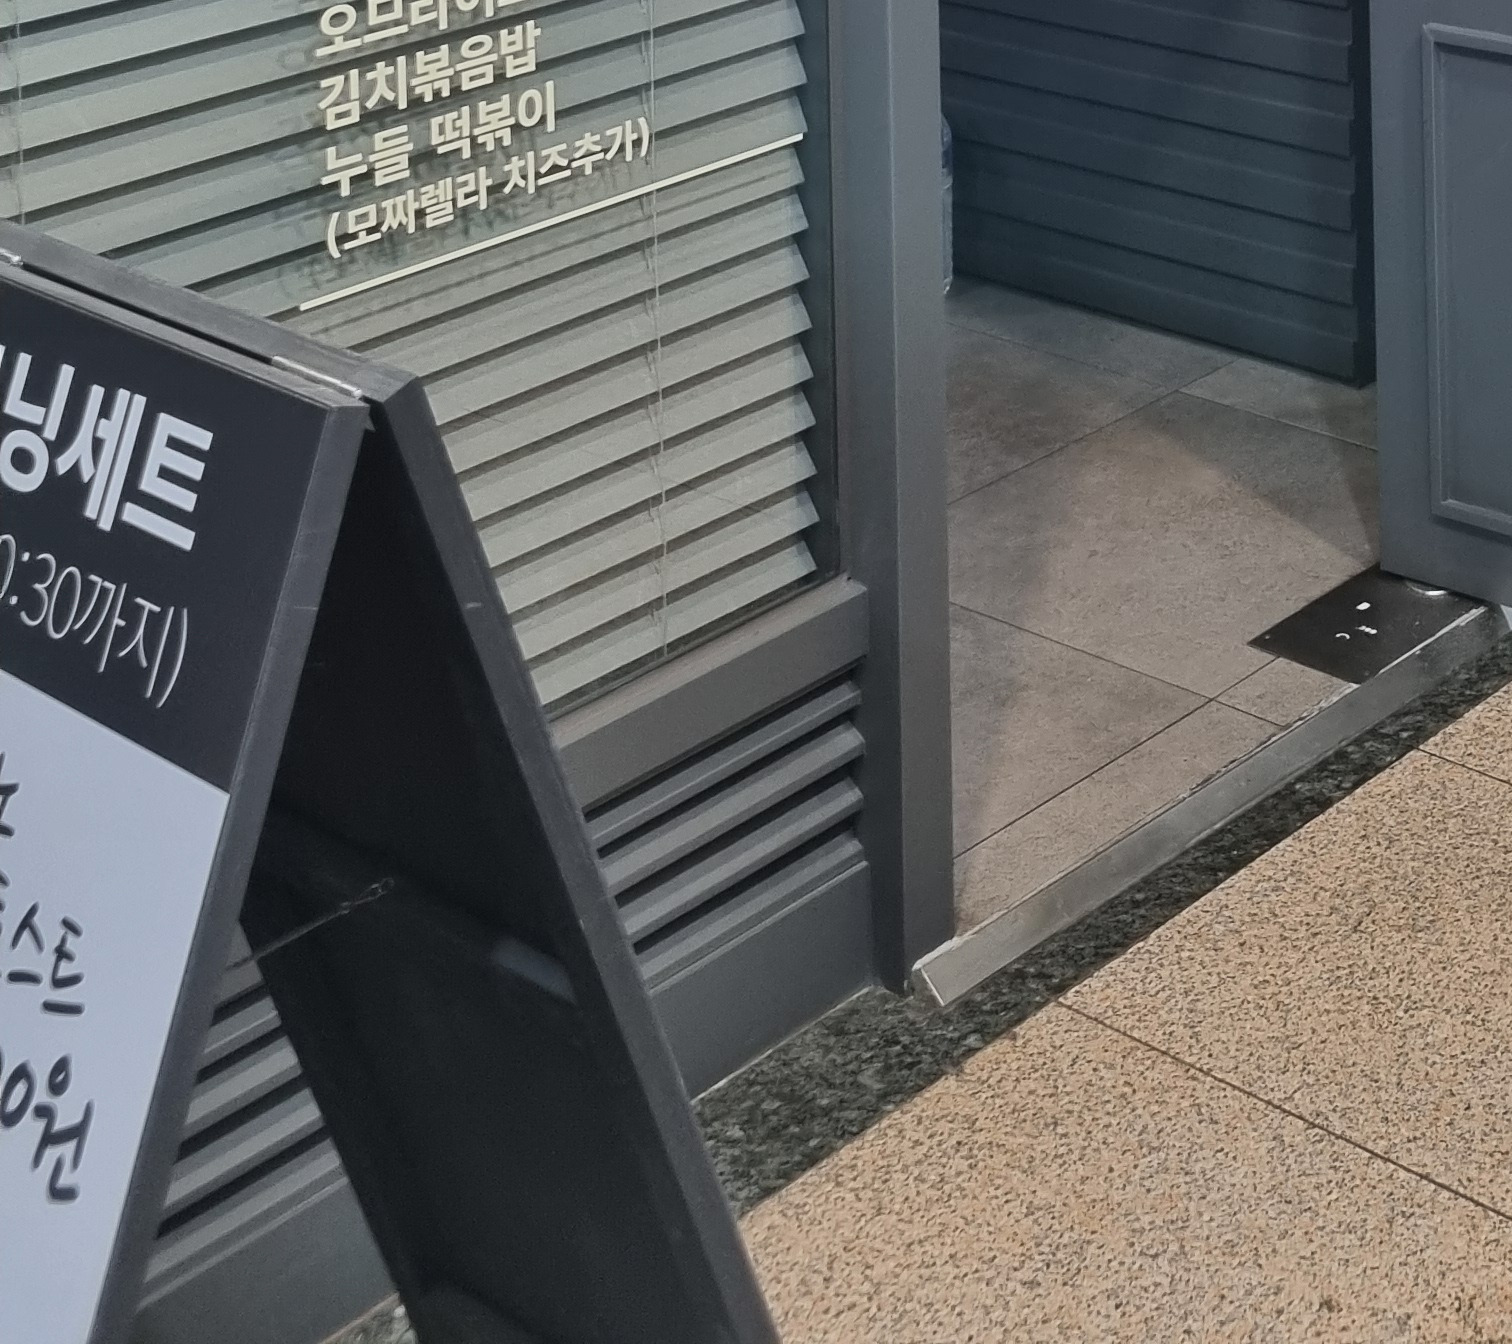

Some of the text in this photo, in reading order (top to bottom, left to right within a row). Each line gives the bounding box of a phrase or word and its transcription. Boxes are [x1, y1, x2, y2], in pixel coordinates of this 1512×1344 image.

[318, 19, 542, 131] 김치볶음밥
[320, 80, 555, 197] 누들 떡볶이
[326, 117, 651, 258] (모짜렐라 치즈추가)
[0, 344, 213, 552] 닝세트
[0, 872, 84, 1014] 스트
[0, 1050, 95, 1202] 0원
